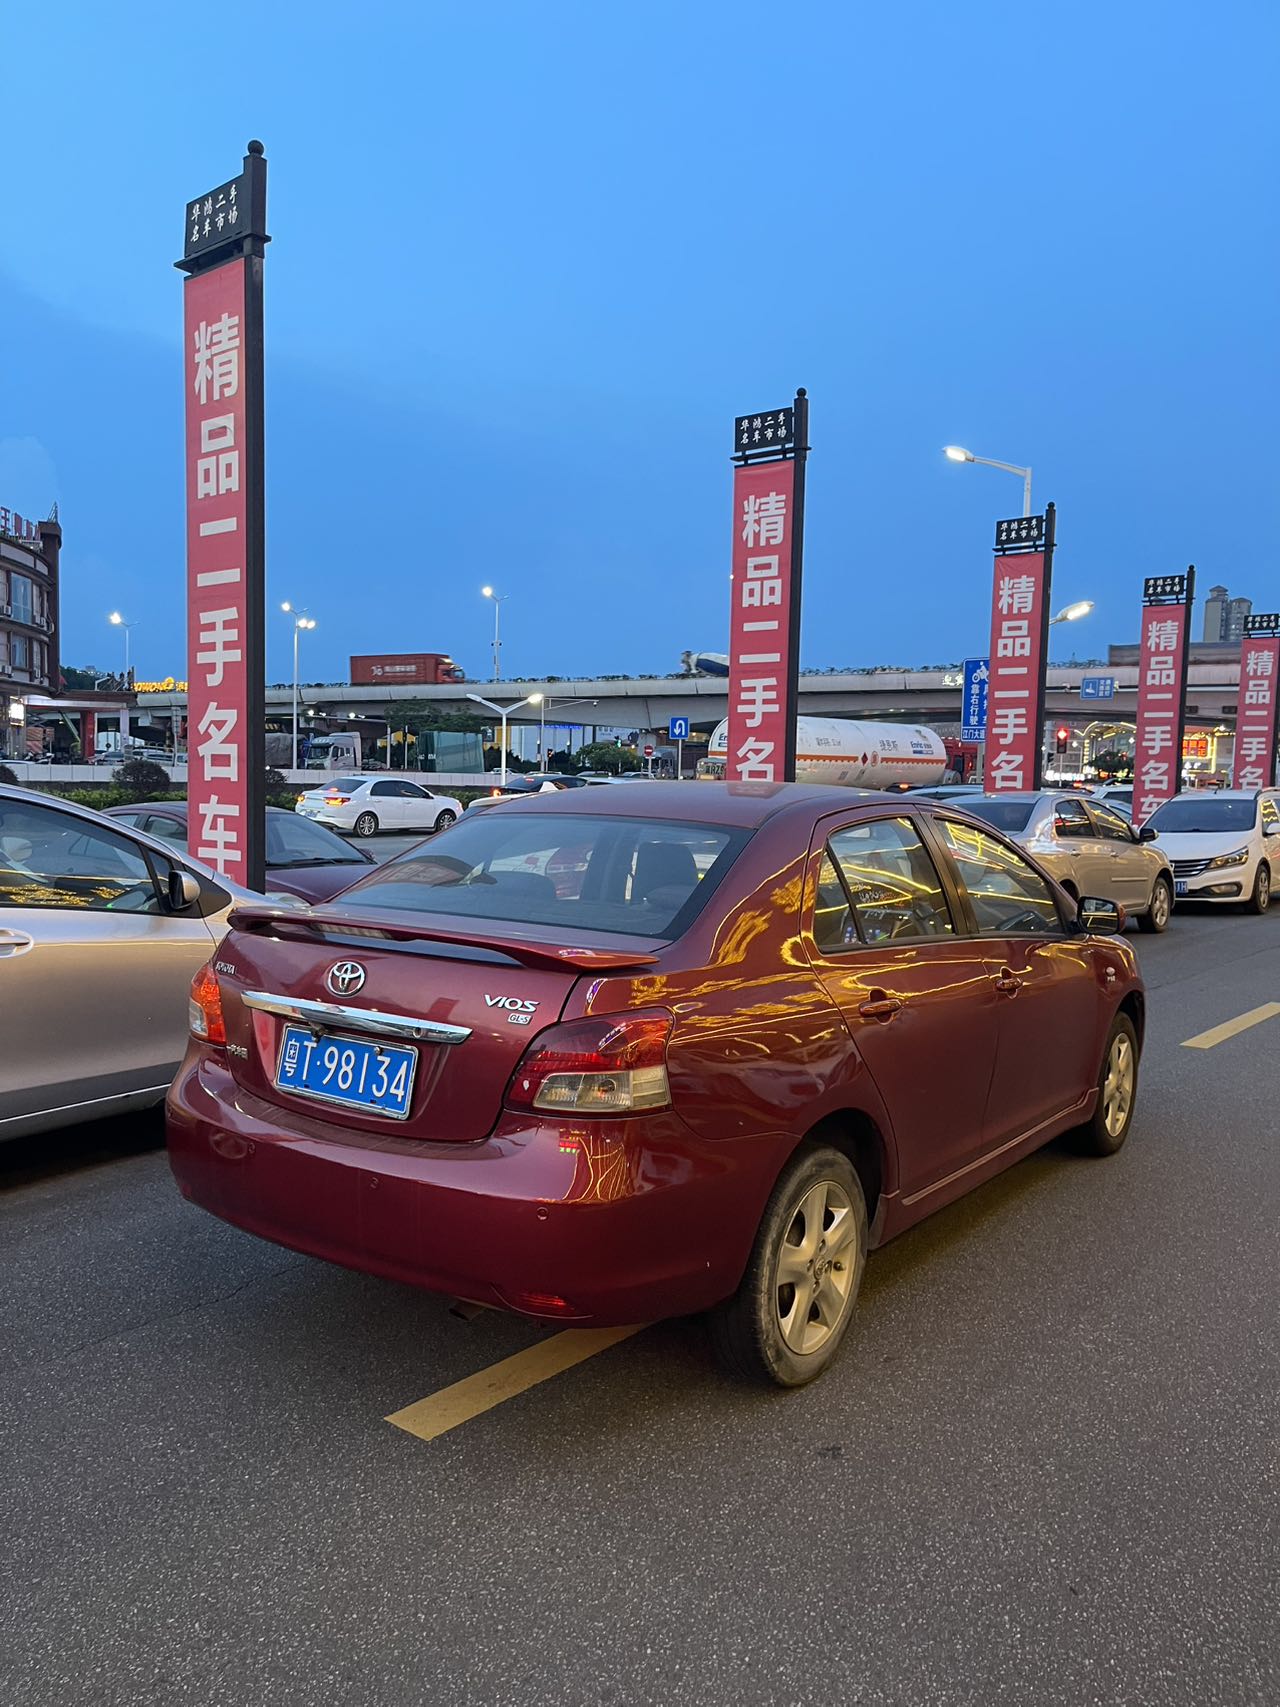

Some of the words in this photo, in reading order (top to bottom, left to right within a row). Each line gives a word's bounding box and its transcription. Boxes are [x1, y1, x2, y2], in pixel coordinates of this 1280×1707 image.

[740, 426, 787, 444] 名车市场
[194, 312, 242, 878] 精品二手名车
[736, 491, 786, 782] 精品二手名
[991, 575, 1036, 789] 精品二手名
[1238, 650, 1274, 791] 精品二手名
[282, 1038, 408, 1102] 粤T·98134
[484, 994, 540, 1012] VIOS
